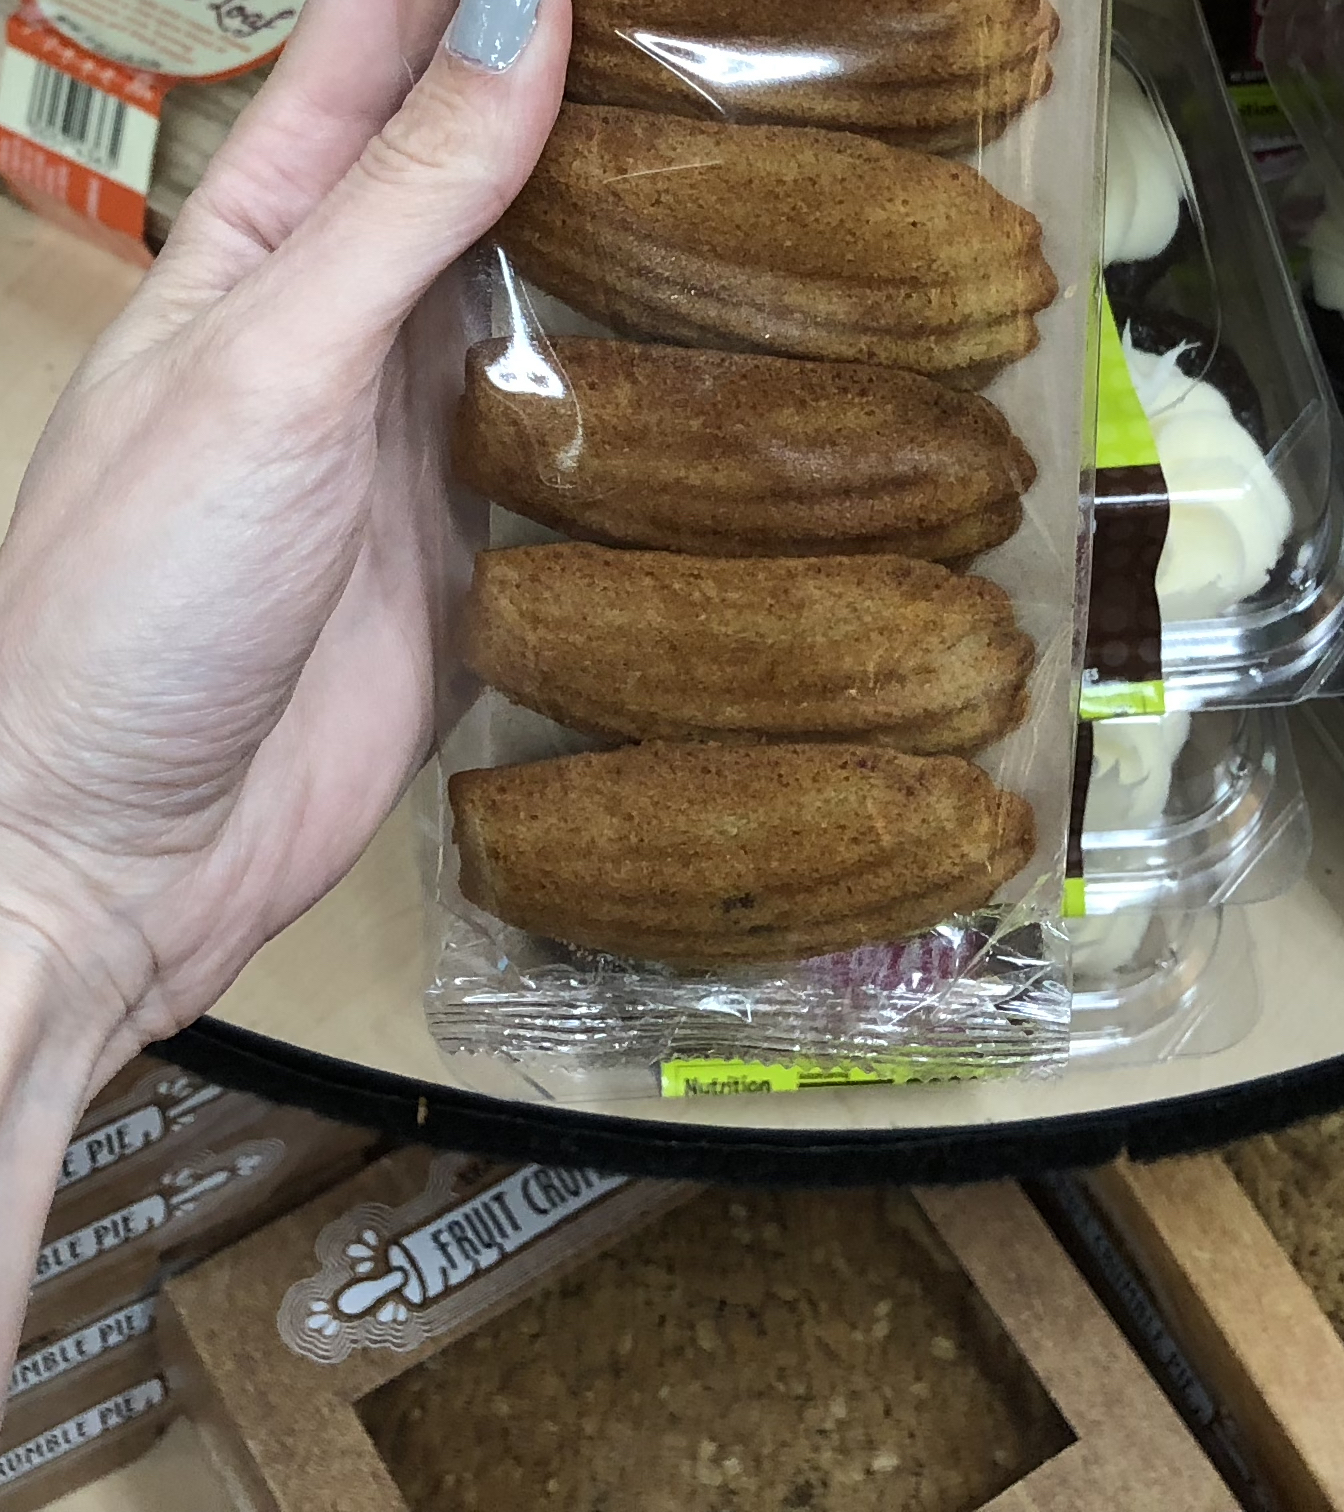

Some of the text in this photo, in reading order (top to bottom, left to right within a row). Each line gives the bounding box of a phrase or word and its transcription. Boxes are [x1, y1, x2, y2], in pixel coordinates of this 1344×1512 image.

[86, 1122, 132, 1165] PIE
[94, 1216, 135, 1246] PIE
[431, 1191, 522, 1270] FRUIT
[99, 1314, 135, 1348] PIE
[99, 1395, 136, 1430] PIE
